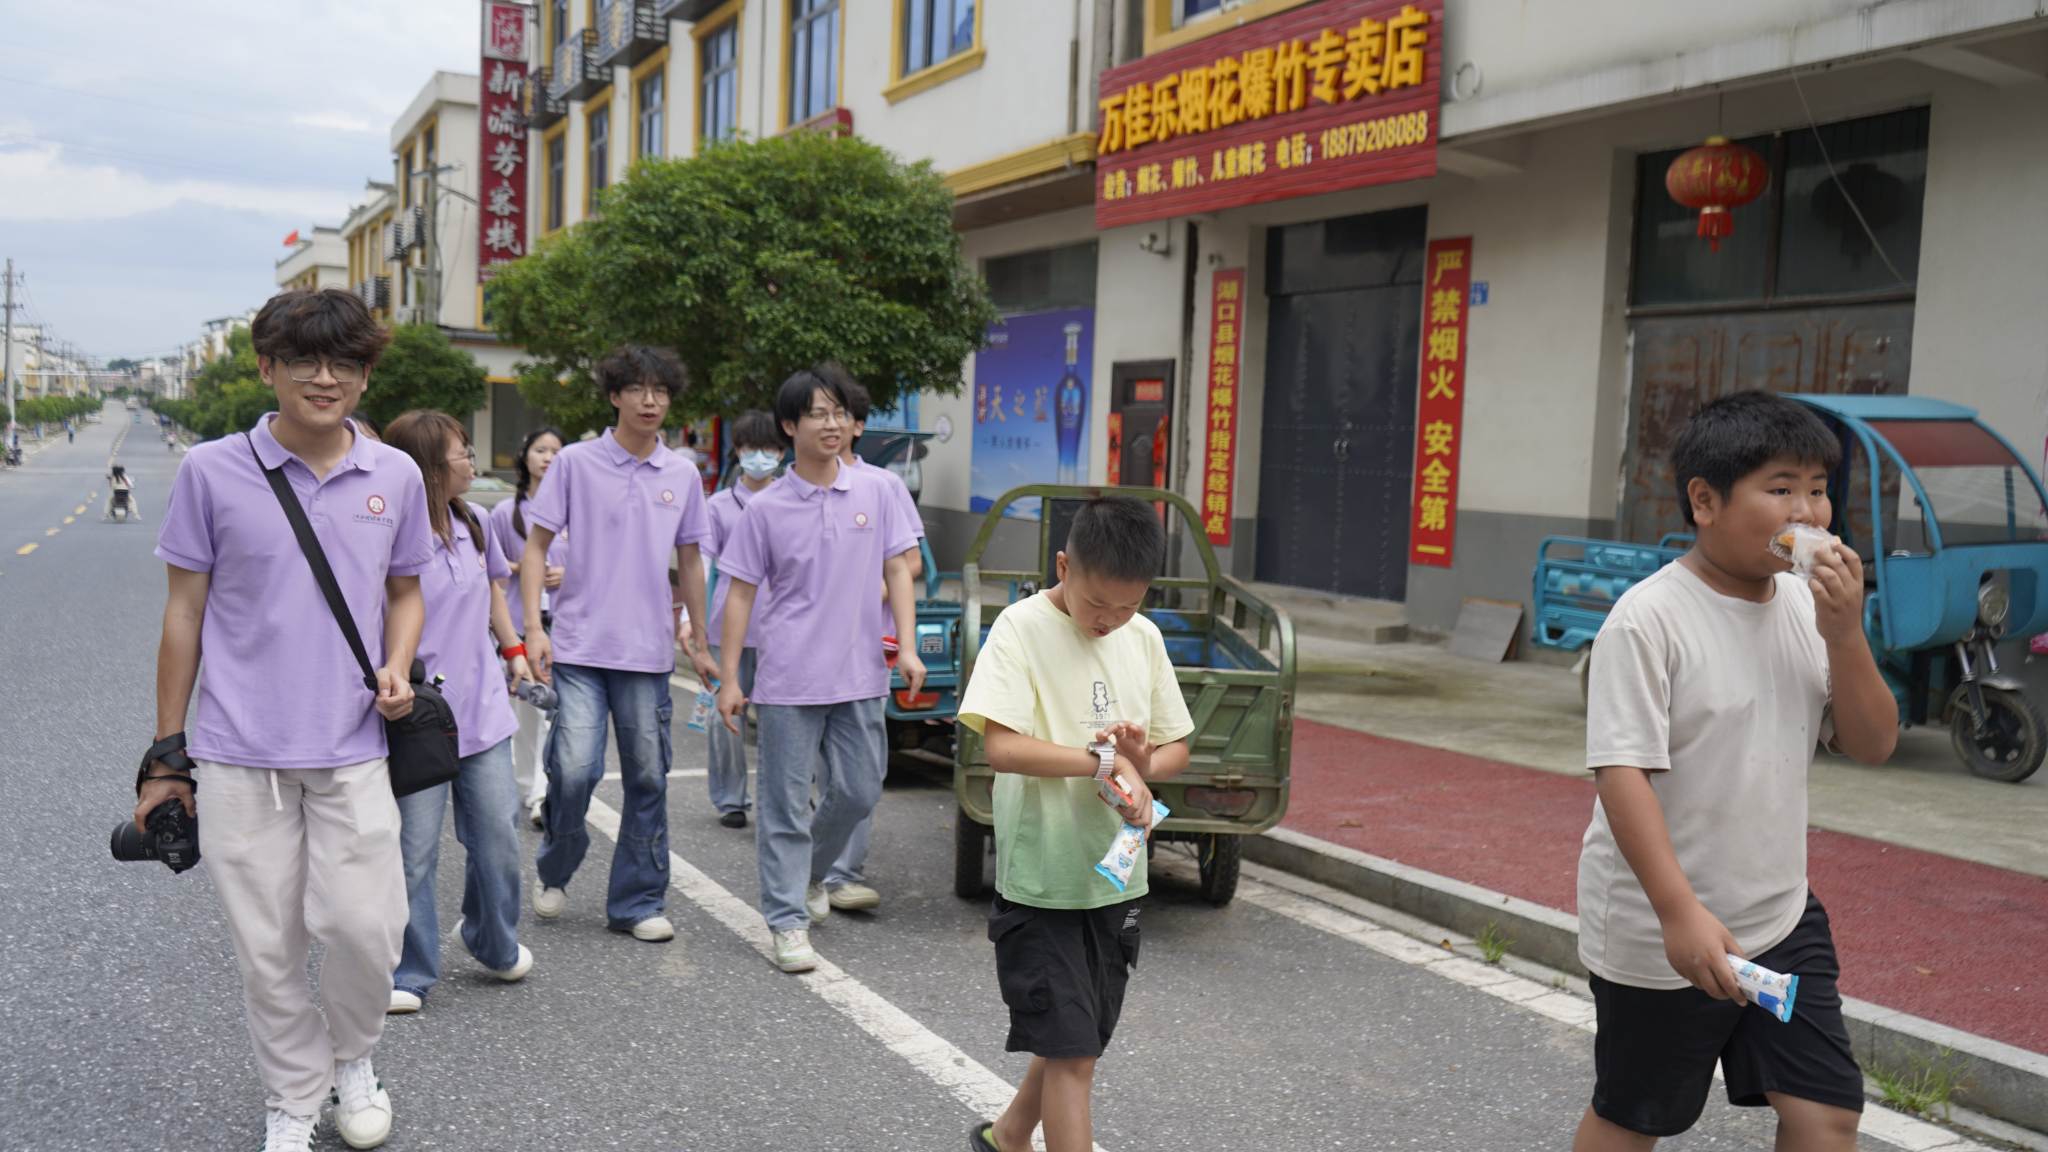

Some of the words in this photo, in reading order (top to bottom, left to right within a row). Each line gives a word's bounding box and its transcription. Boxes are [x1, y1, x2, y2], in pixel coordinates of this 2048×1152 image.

[486, 63, 524, 256] 新流芳客栈
[1098, 5, 1429, 155] 万佳乐烟花爆竹专卖店
